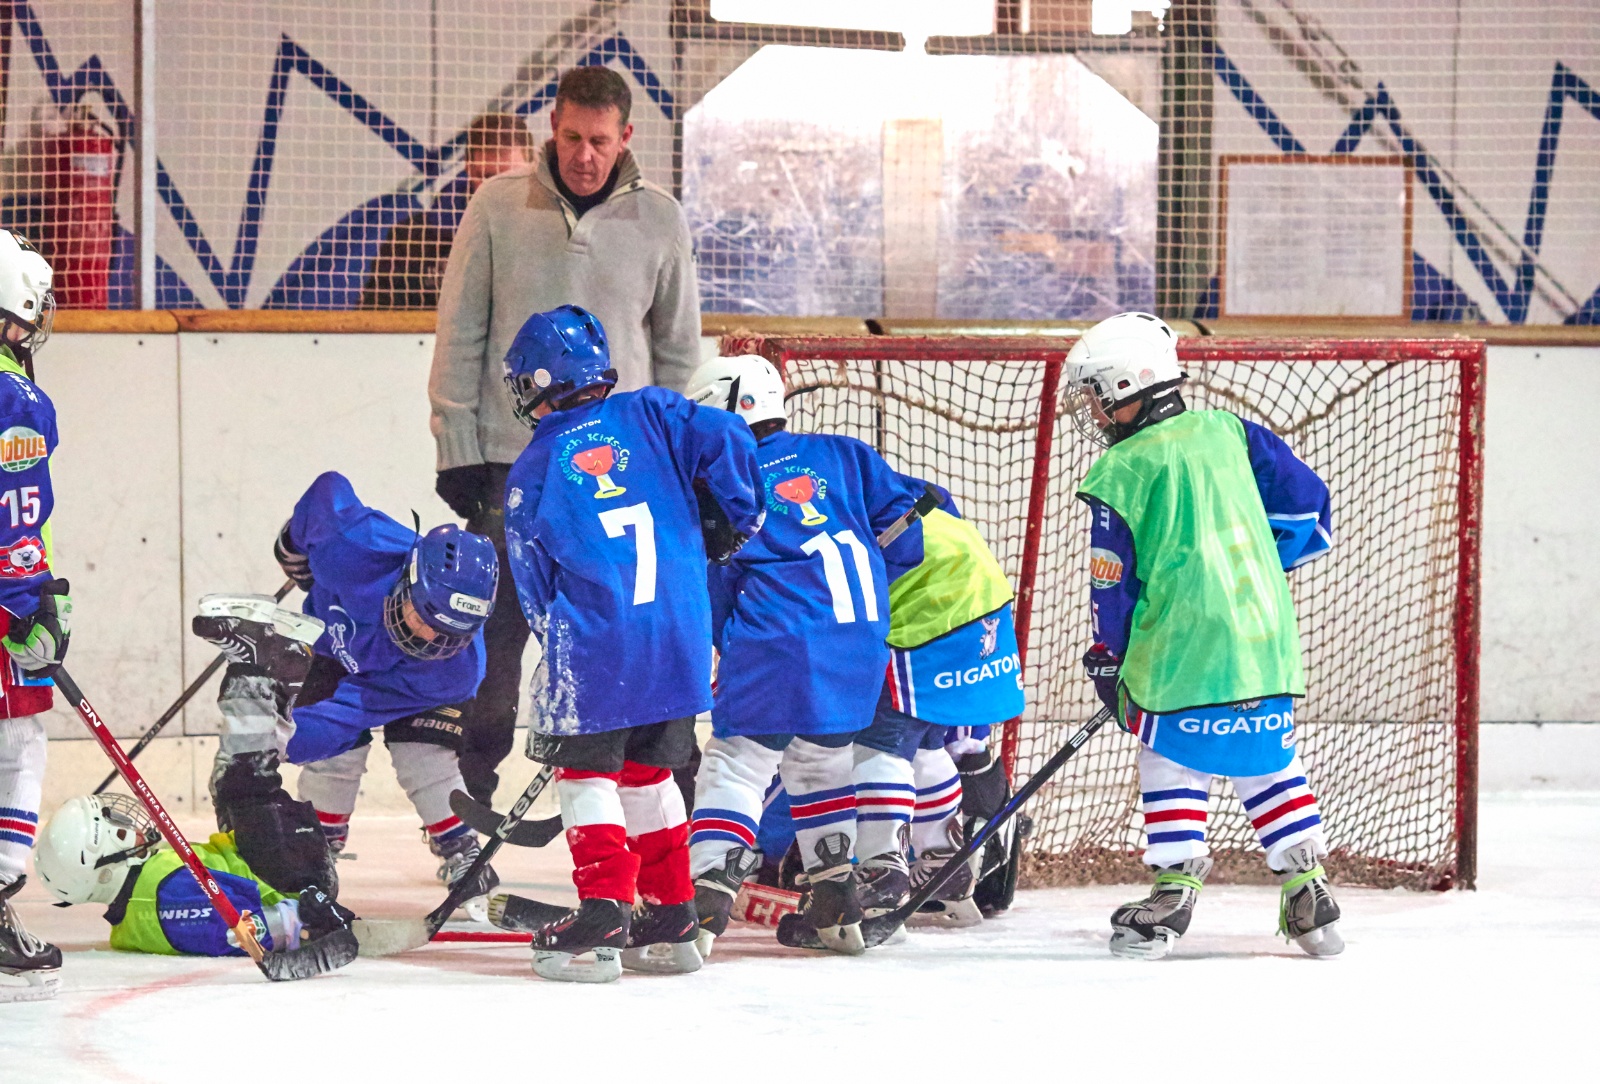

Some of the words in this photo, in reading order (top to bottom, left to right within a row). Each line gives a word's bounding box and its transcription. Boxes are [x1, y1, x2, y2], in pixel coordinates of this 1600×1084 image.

[564, 419, 602, 435] EASTON
[0, 434, 48, 463] lobus
[763, 453, 798, 469] EASTON
[0, 485, 41, 528] 15
[597, 501, 657, 606] 7
[799, 529, 879, 624] 11
[456, 597, 482, 612] Franz
[933, 653, 1021, 689] GIGATON
[410, 717, 464, 737] BAUER
[1178, 711, 1294, 736] GIGATON
[495, 764, 554, 839] Reeb
[136, 778, 162, 812] ULTRA
[159, 811, 193, 856] EXTREME
[158, 907, 214, 920] SCHM
